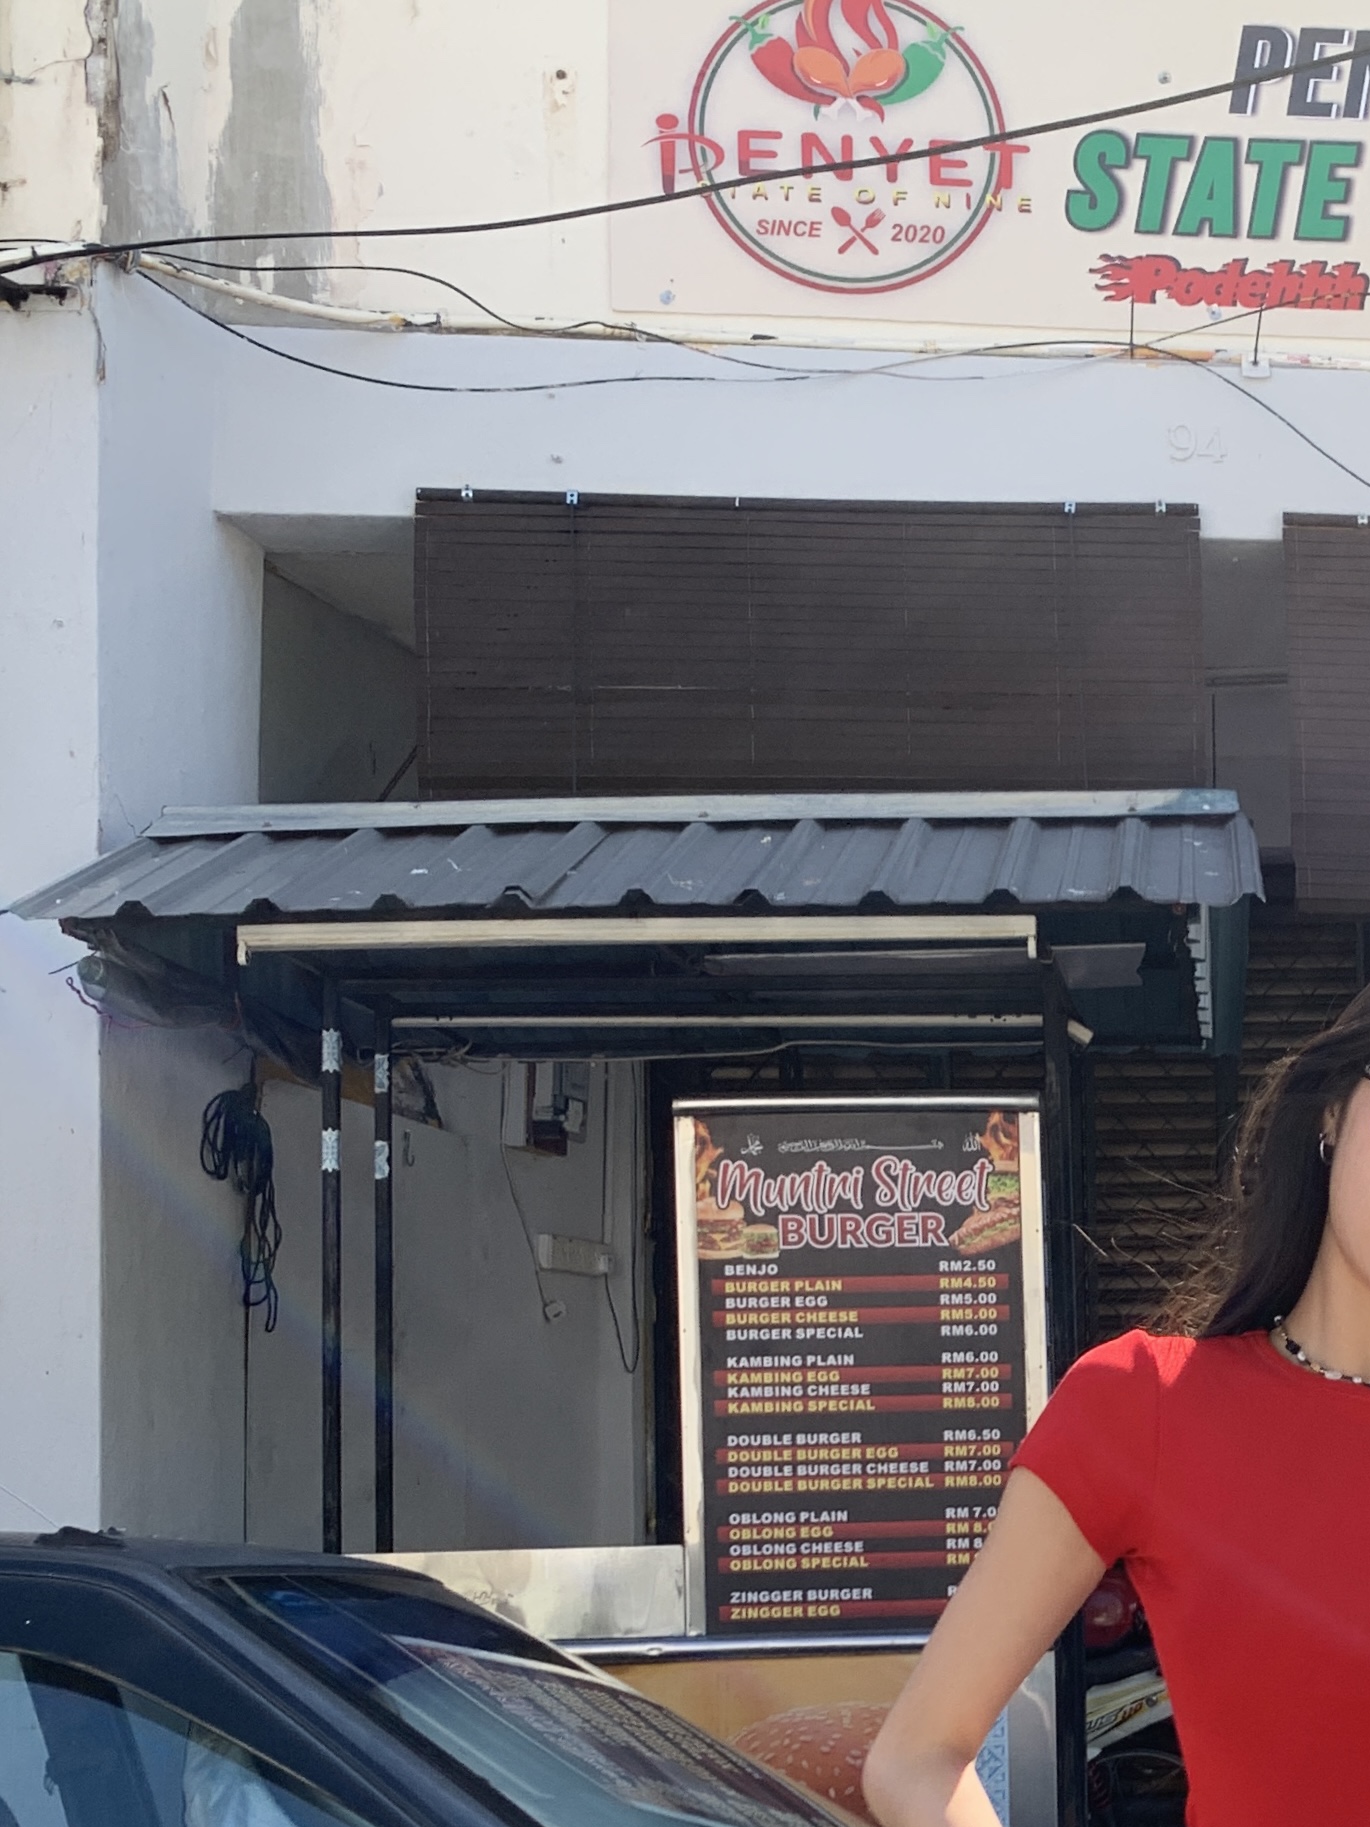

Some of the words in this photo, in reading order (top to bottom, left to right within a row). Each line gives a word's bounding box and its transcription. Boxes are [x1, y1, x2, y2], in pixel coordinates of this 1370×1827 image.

[1065, 129, 1362, 243] STATE
[855, 187, 909, 206] OF
[934, 191, 1032, 213] NINE
[756, 218, 823, 238] SINCE
[890, 223, 945, 245] 2020
[717, 1159, 864, 1216] Muntri
[871, 1155, 993, 1213] Street
[779, 1213, 949, 1249] BURGER
[725, 1264, 778, 1275] BENJO
[939, 1260, 995, 1271] RM2.50
[726, 1281, 789, 1292] BURGER
[795, 1280, 841, 1291] PLAIN
[940, 1277, 995, 1288] RM4.50
[726, 1297, 790, 1308] BURGER
[795, 1296, 827, 1307] EGG
[940, 1293, 996, 1304] RM5.00
[726, 1313, 791, 1324] BURGER
[796, 1311, 857, 1323] CHEESE
[941, 1308, 997, 1319] RM5.00
[727, 1329, 791, 1340] BURGER
[796, 1327, 863, 1339] SPECIAL
[941, 1324, 997, 1336] RM6.00
[727, 1356, 802, 1367] KAMBING
[807, 1355, 853, 1366] PLAIN
[942, 1352, 998, 1363] RM6.00
[728, 1372, 802, 1384] KAMBING
[807, 1371, 839, 1382] EGG
[943, 1367, 998, 1380] RM7.00
[728, 1386, 803, 1397] KAMBING
[808, 1384, 869, 1396] CHEESE
[943, 1381, 999, 1392] RM7.00
[728, 1401, 803, 1413] KAMBING
[808, 1400, 874, 1411] SPECIAL
[728, 1434, 791, 1446] DOUBLE
[796, 1433, 861, 1444] BURGER
[944, 1429, 1000, 1440] RM6.50
[728, 1450, 791, 1462] DOUBLE
[797, 1448, 861, 1460] BURGER
[866, 1447, 898, 1458] EGG
[944, 1445, 1000, 1456] RM7.00
[729, 1466, 792, 1477] DOUBLE
[797, 1464, 861, 1475] BURGER
[867, 1462, 928, 1474] CHEESE
[945, 1460, 1001, 1471] RM7.00
[729, 1480, 792, 1492] DOUBLE
[798, 1478, 862, 1490] BURGER
[867, 1477, 933, 1489] SPECIAL
[945, 1475, 1001, 1487] RM8.00
[729, 1512, 795, 1524] OBLONG
[800, 1511, 847, 1522] PLAIN
[946, 1508, 968, 1518] RM
[730, 1527, 796, 1539] OBLONG
[800, 1526, 833, 1538] EGG
[946, 1523, 969, 1533] RM
[730, 1544, 796, 1556] OBLONG
[801, 1542, 863, 1553] CHEESE
[947, 1538, 969, 1549] RM
[730, 1558, 796, 1571] OBLONG
[801, 1556, 868, 1568] SPECIAL
[947, 1553, 969, 1564] RM
[808, 1588, 872, 1600] BURGER
[808, 1605, 840, 1616] EGG
